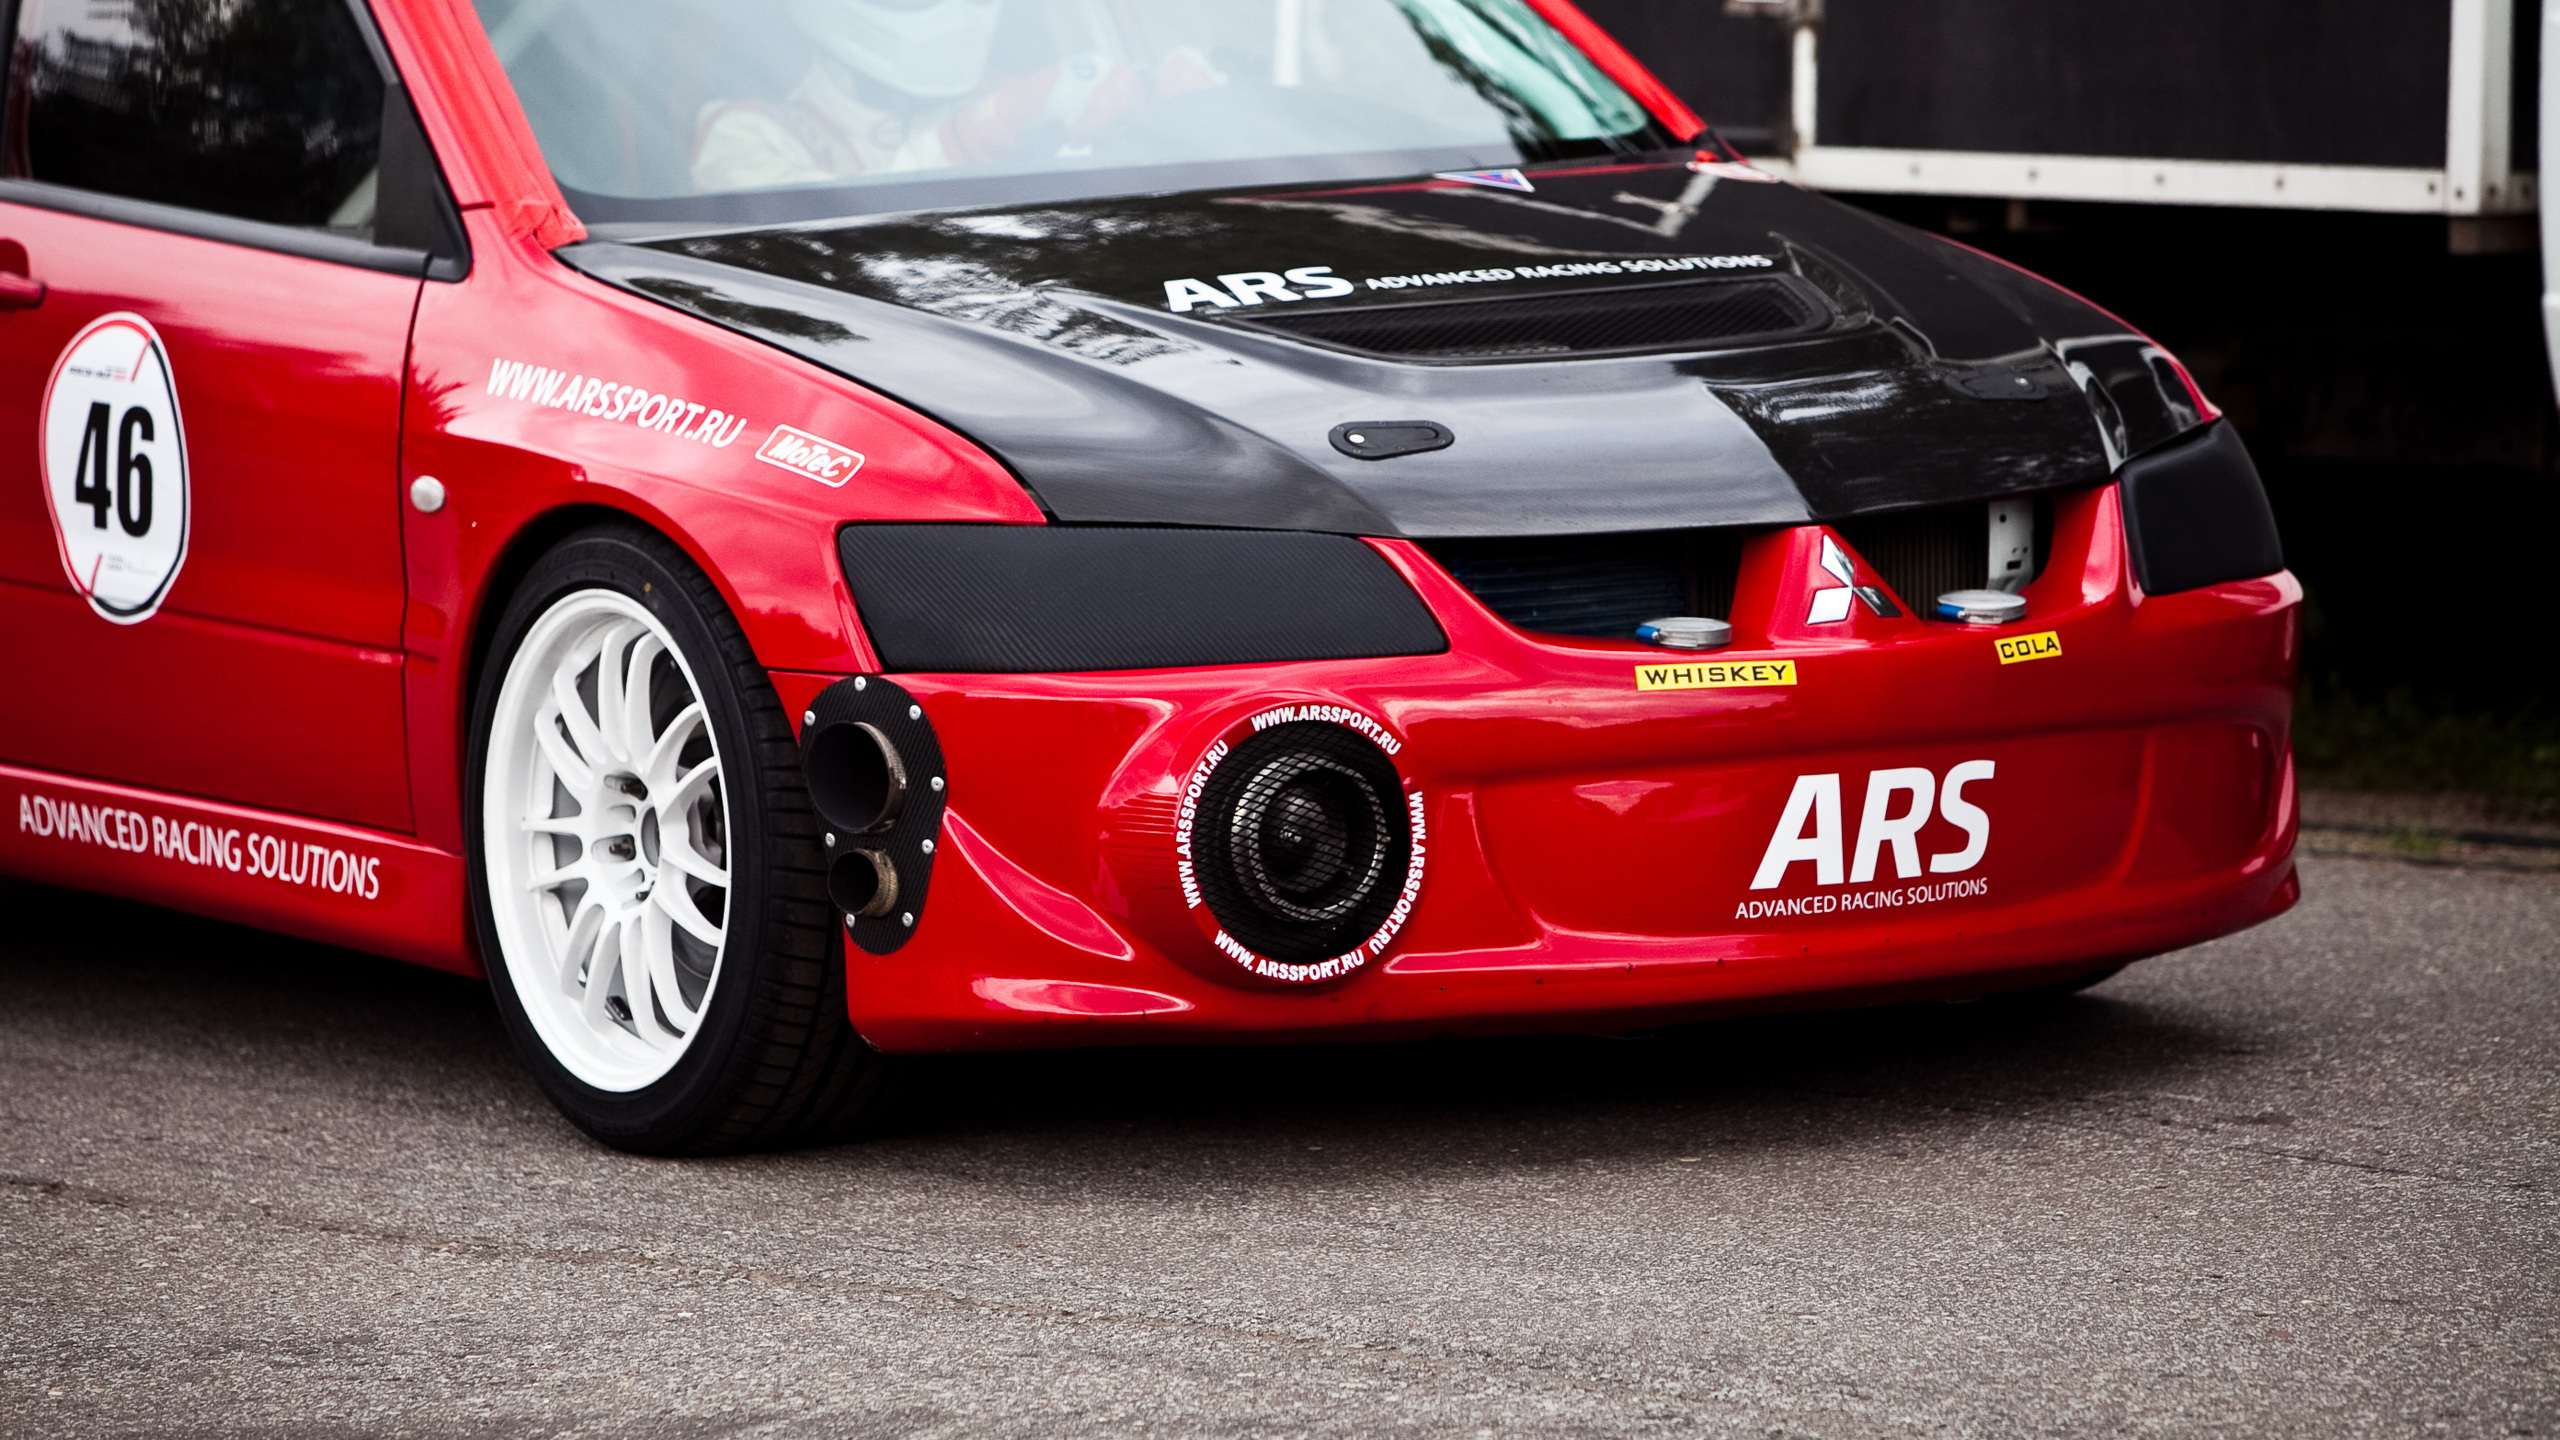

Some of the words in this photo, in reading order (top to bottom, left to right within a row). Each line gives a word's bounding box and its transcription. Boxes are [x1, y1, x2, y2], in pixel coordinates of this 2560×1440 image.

[1163, 266, 1354, 313] ARS
[1365, 267, 1514, 290] ADVANCED
[1515, 261, 1622, 279] RACING
[1620, 254, 1773, 273] SOLUTIONS
[487, 358, 747, 448] WWW.ARSSPORT.RU
[75, 401, 154, 537] 46
[767, 434, 851, 477] MoTeC
[2001, 636, 2059, 659] COLA
[1644, 665, 1787, 685] WHISKEY
[1251, 705, 1401, 755] WWW.ARSSPORT.RU
[17, 794, 148, 853] ADVANCED
[152, 816, 241, 871] RACING
[246, 833, 380, 899] SOLUTIONS
[1176, 740, 1229, 909] WWW.ARSSPORT.RU
[1750, 759, 1995, 890] ARS
[1369, 792, 1426, 954] WWW.ARSSPORT.RU
[1735, 895, 1836, 919] ADVANCED
[1841, 889, 1903, 911] RACING
[1907, 877, 1988, 904] SOLUTIONS
